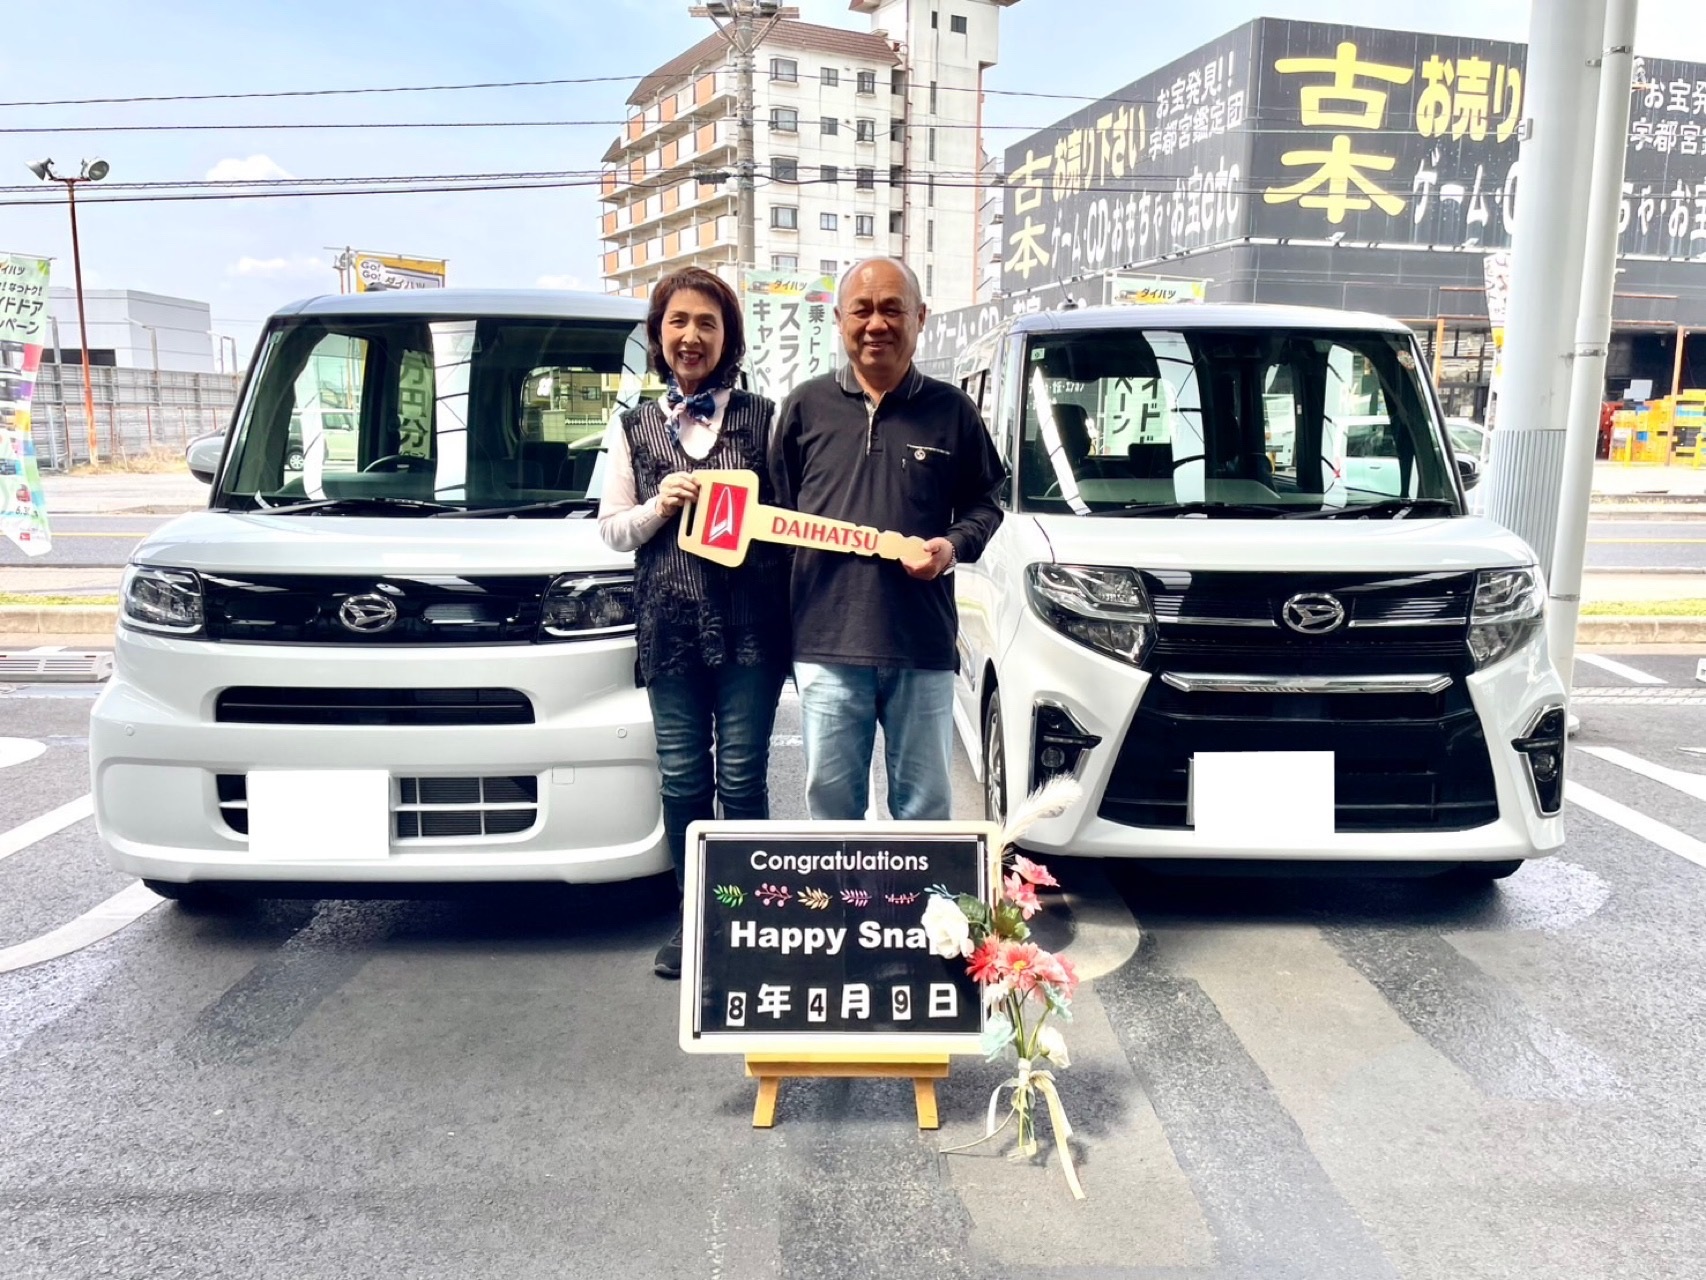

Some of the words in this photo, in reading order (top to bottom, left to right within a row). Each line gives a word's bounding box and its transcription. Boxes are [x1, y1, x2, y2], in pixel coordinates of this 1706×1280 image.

[1416, 55, 1521, 143] お売り
[1264, 42, 1414, 224] 古本
[1630, 117, 1706, 155] 宇都宮
[1052, 105, 1145, 203] お売り下さい
[1004, 150, 1052, 280] 古本
[774, 279, 808, 291] ダイハツ
[1141, 287, 1176, 299] ダイハツ
[0, 318, 39, 335] ペーン
[771, 516, 879, 551] DAIHATSU
[750, 850, 929, 875] Congratulations
[730, 920, 847, 955] Happy
[858, 921, 937, 955] Sna
